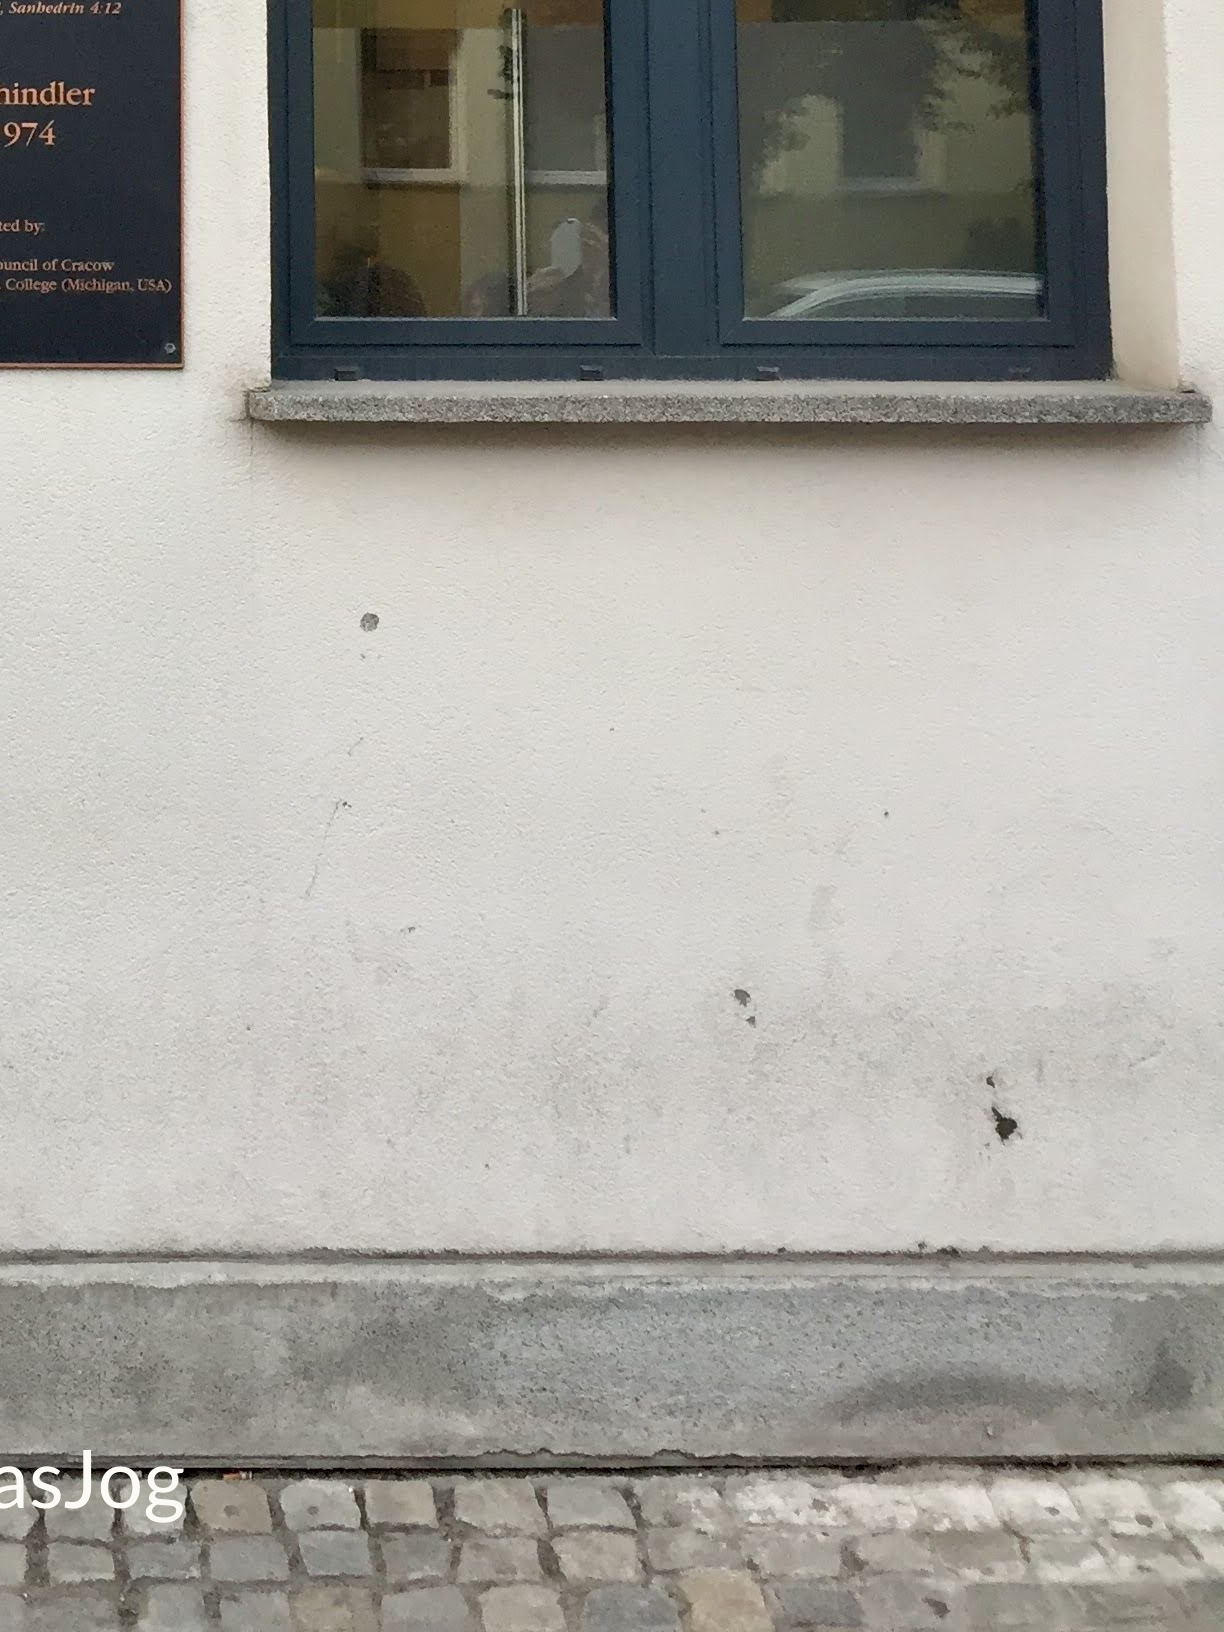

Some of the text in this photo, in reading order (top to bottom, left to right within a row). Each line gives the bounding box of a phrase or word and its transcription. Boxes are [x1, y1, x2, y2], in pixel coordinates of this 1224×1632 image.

[9, 1, 84, 14] Sanhedrin
[42, 259, 58, 271] of
[61, 259, 115, 272] Cracow
[6, 278, 57, 293] College
[137, 279, 172, 293] USA)
